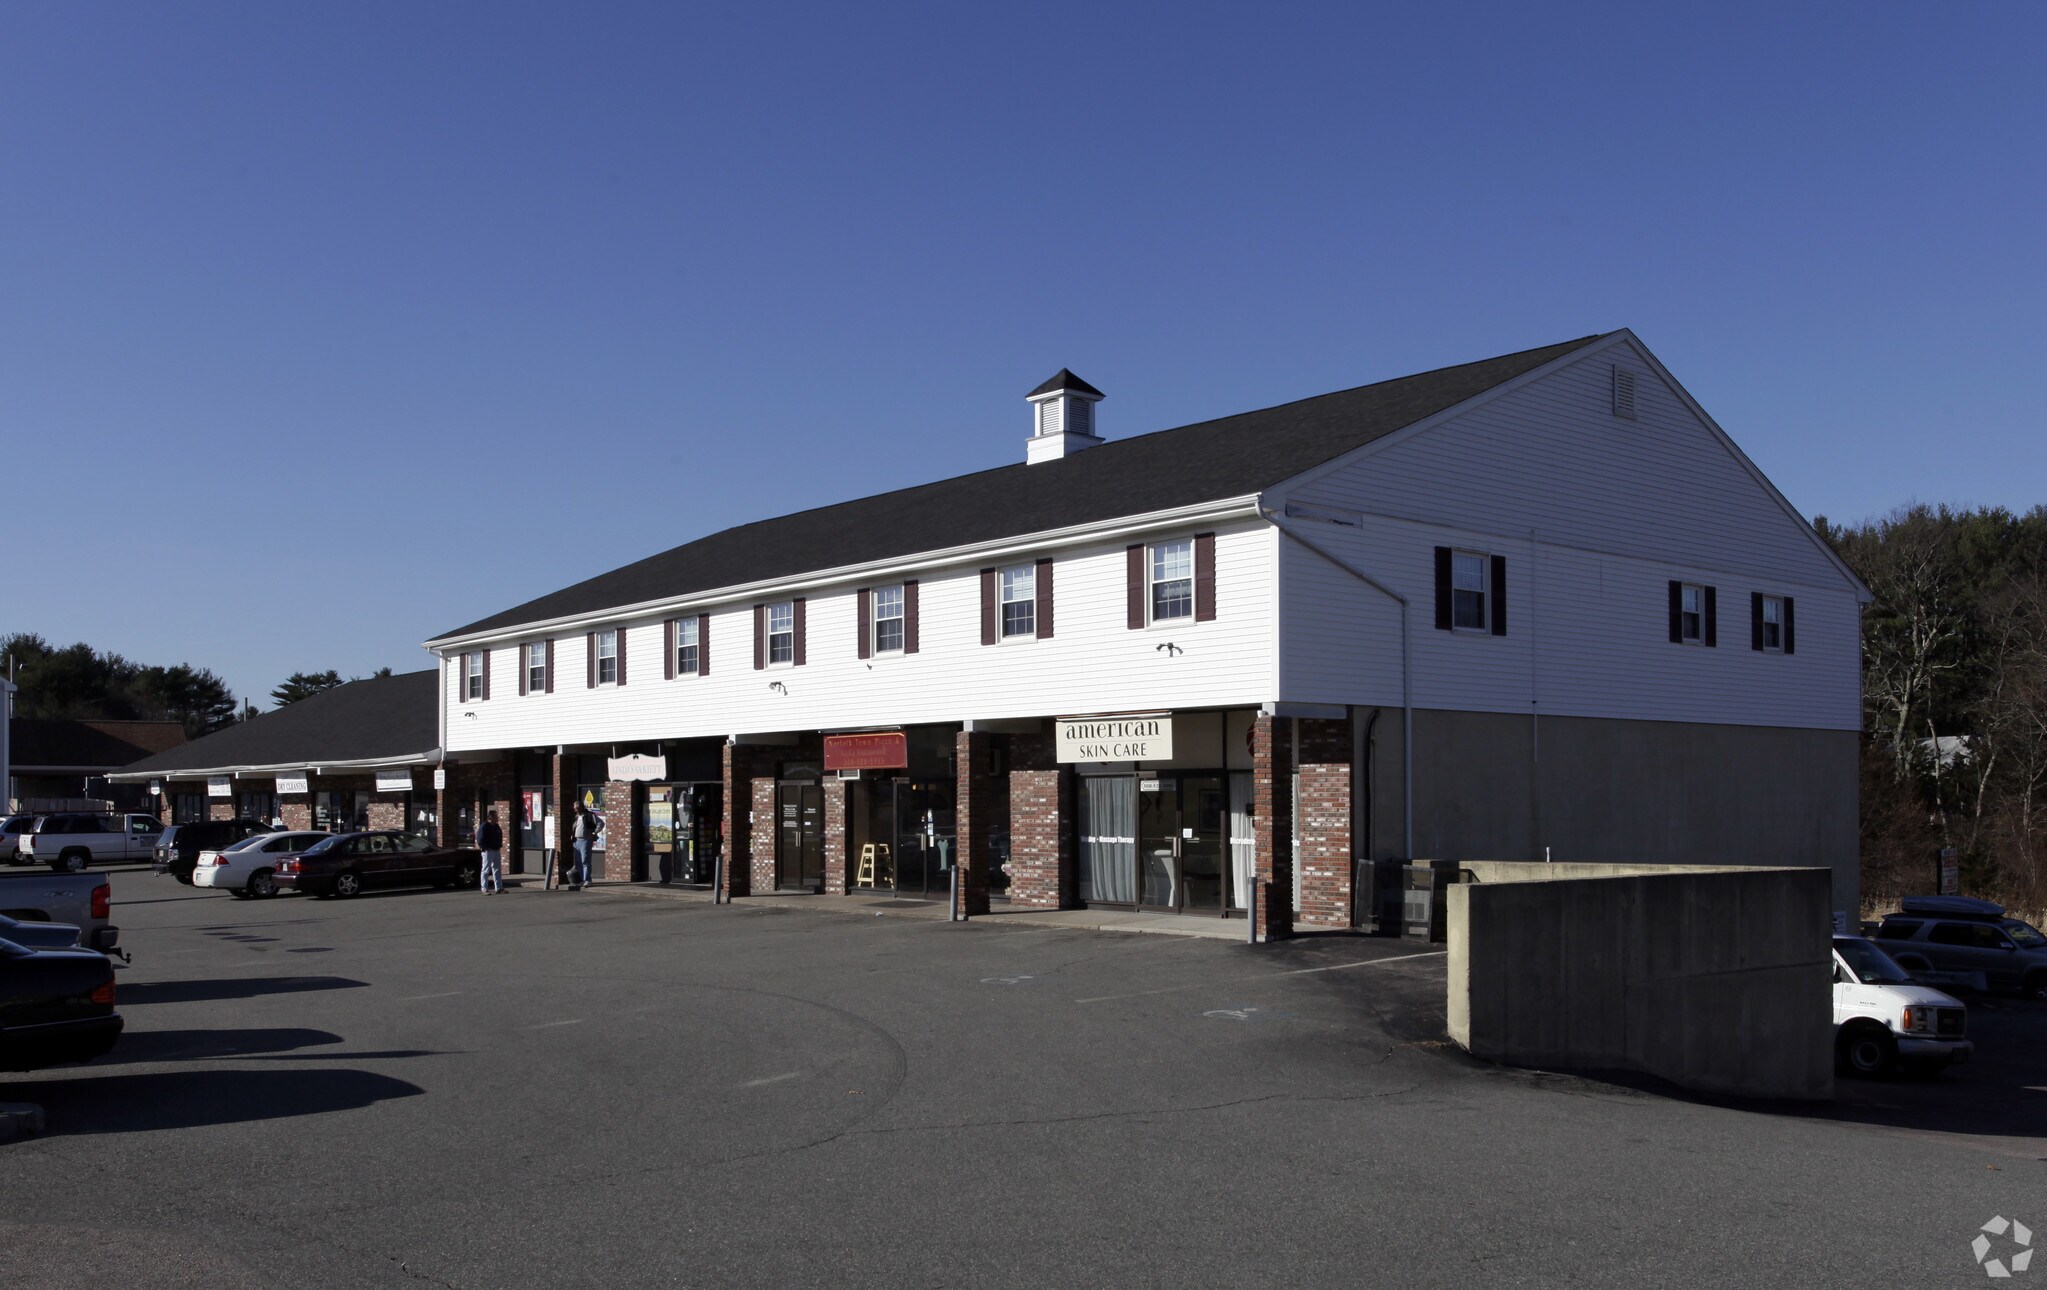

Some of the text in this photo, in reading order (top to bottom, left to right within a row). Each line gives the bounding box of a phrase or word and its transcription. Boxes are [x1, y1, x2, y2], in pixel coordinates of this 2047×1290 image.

[1066, 720, 1160, 740] american
[1079, 743, 1147, 758] SKIN CARE
[286, 781, 306, 791] CLEANING
